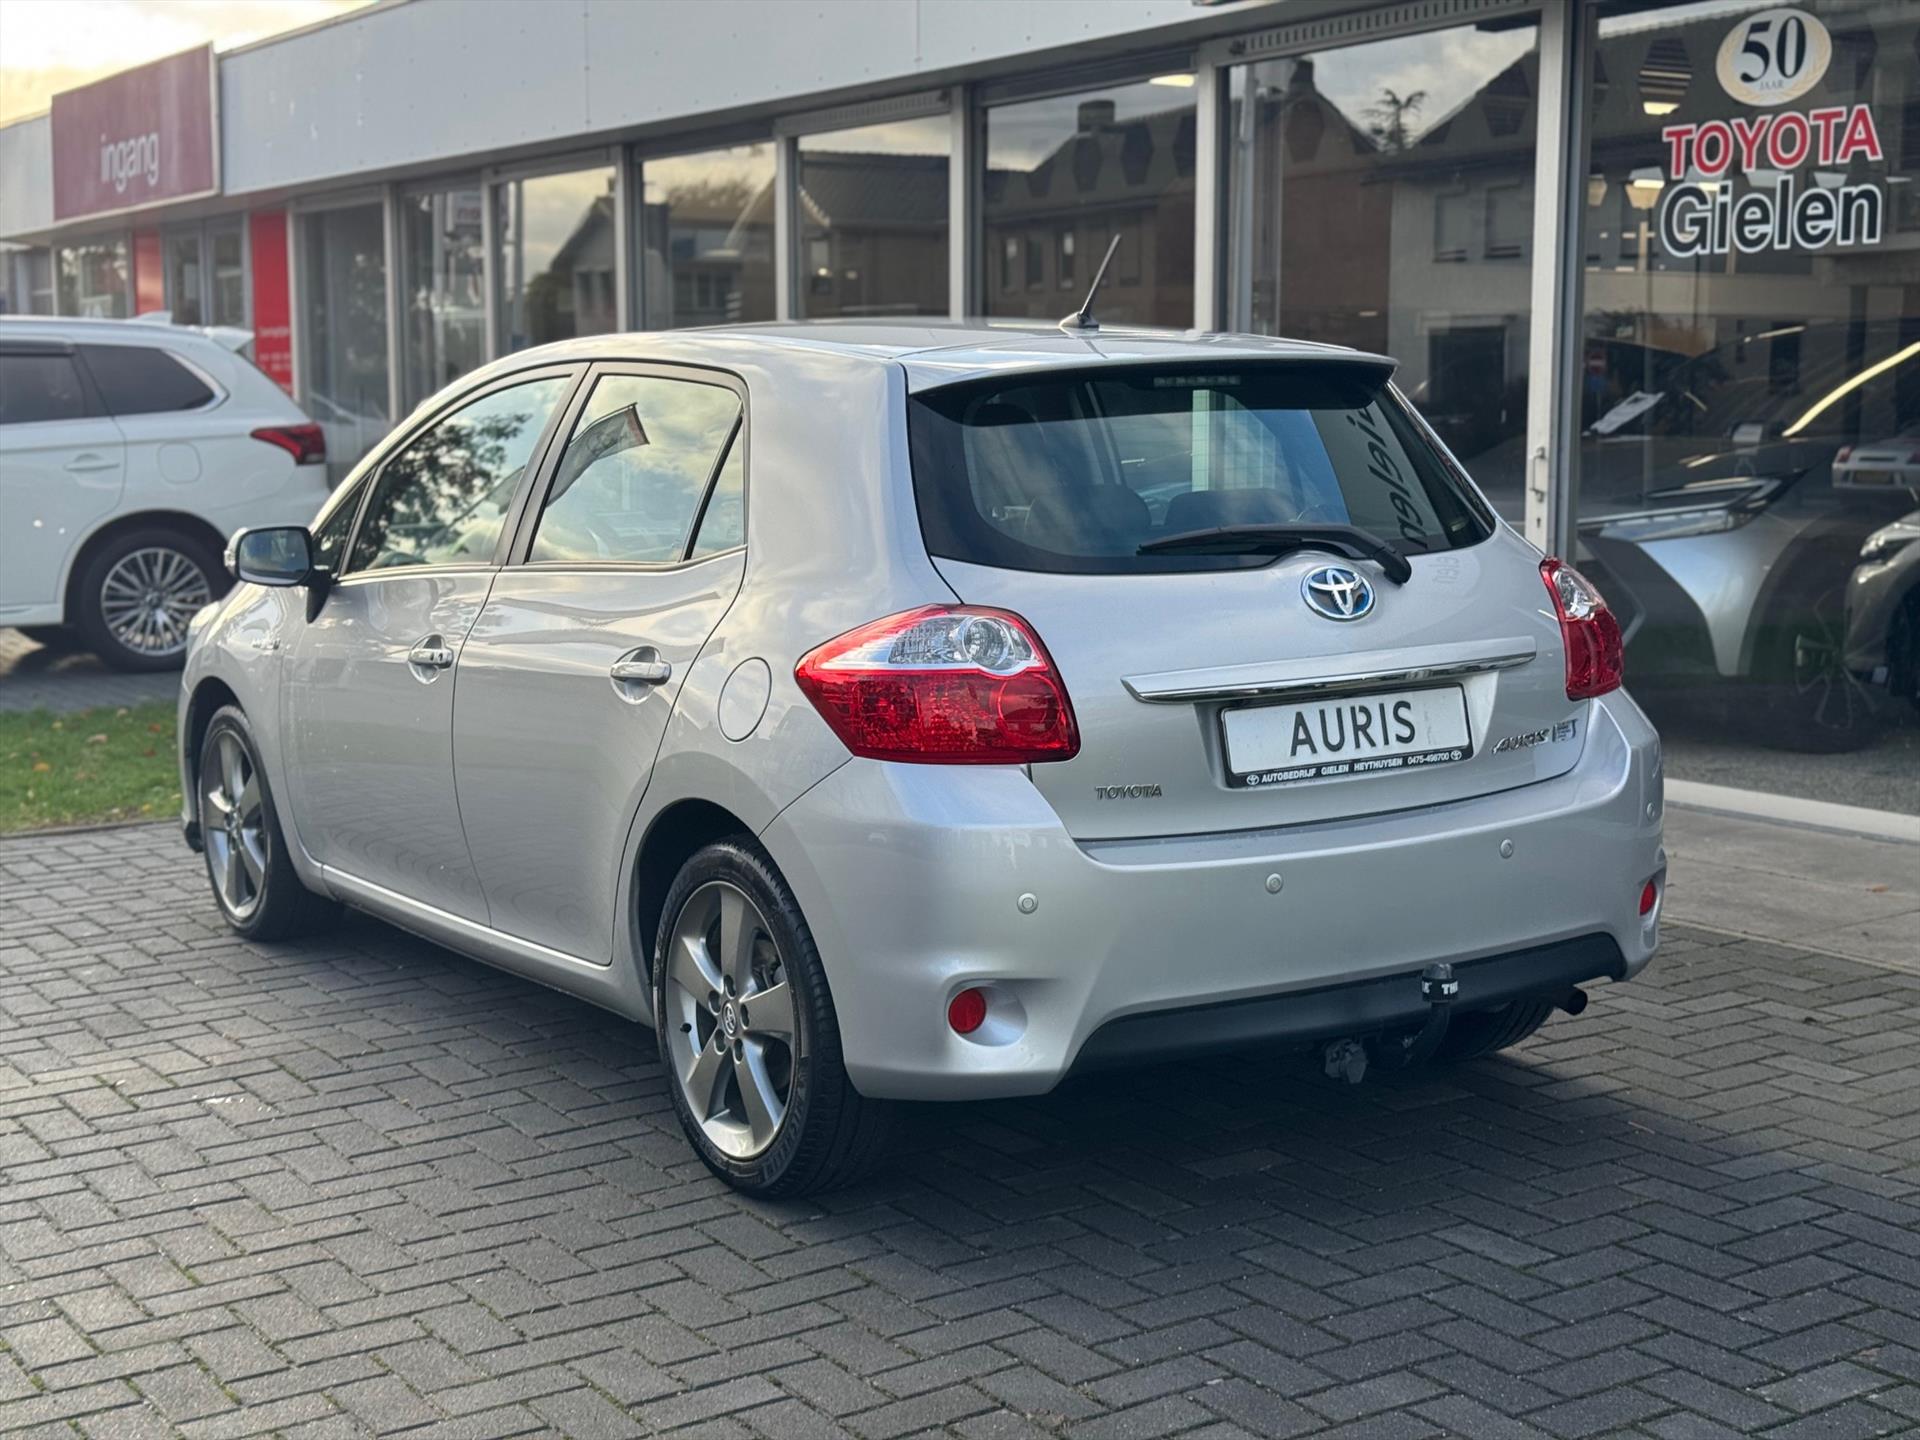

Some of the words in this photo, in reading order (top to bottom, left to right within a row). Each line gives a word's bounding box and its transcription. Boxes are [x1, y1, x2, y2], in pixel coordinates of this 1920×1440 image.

[1740, 16, 1807, 83] 50
[1759, 80, 1785, 90] JAAR
[100, 132, 160, 193] ingang
[1662, 104, 1883, 180] TOYOTA
[1660, 174, 1882, 257] Gielen
[1290, 700, 1416, 757] AURIS
[1095, 783, 1162, 800] TOYOTA
[1261, 768, 1317, 783] AUTOBEDRIJF
[1320, 764, 1350, 775] GIELEN
[1353, 757, 1403, 772] HEYTHUYSEN
